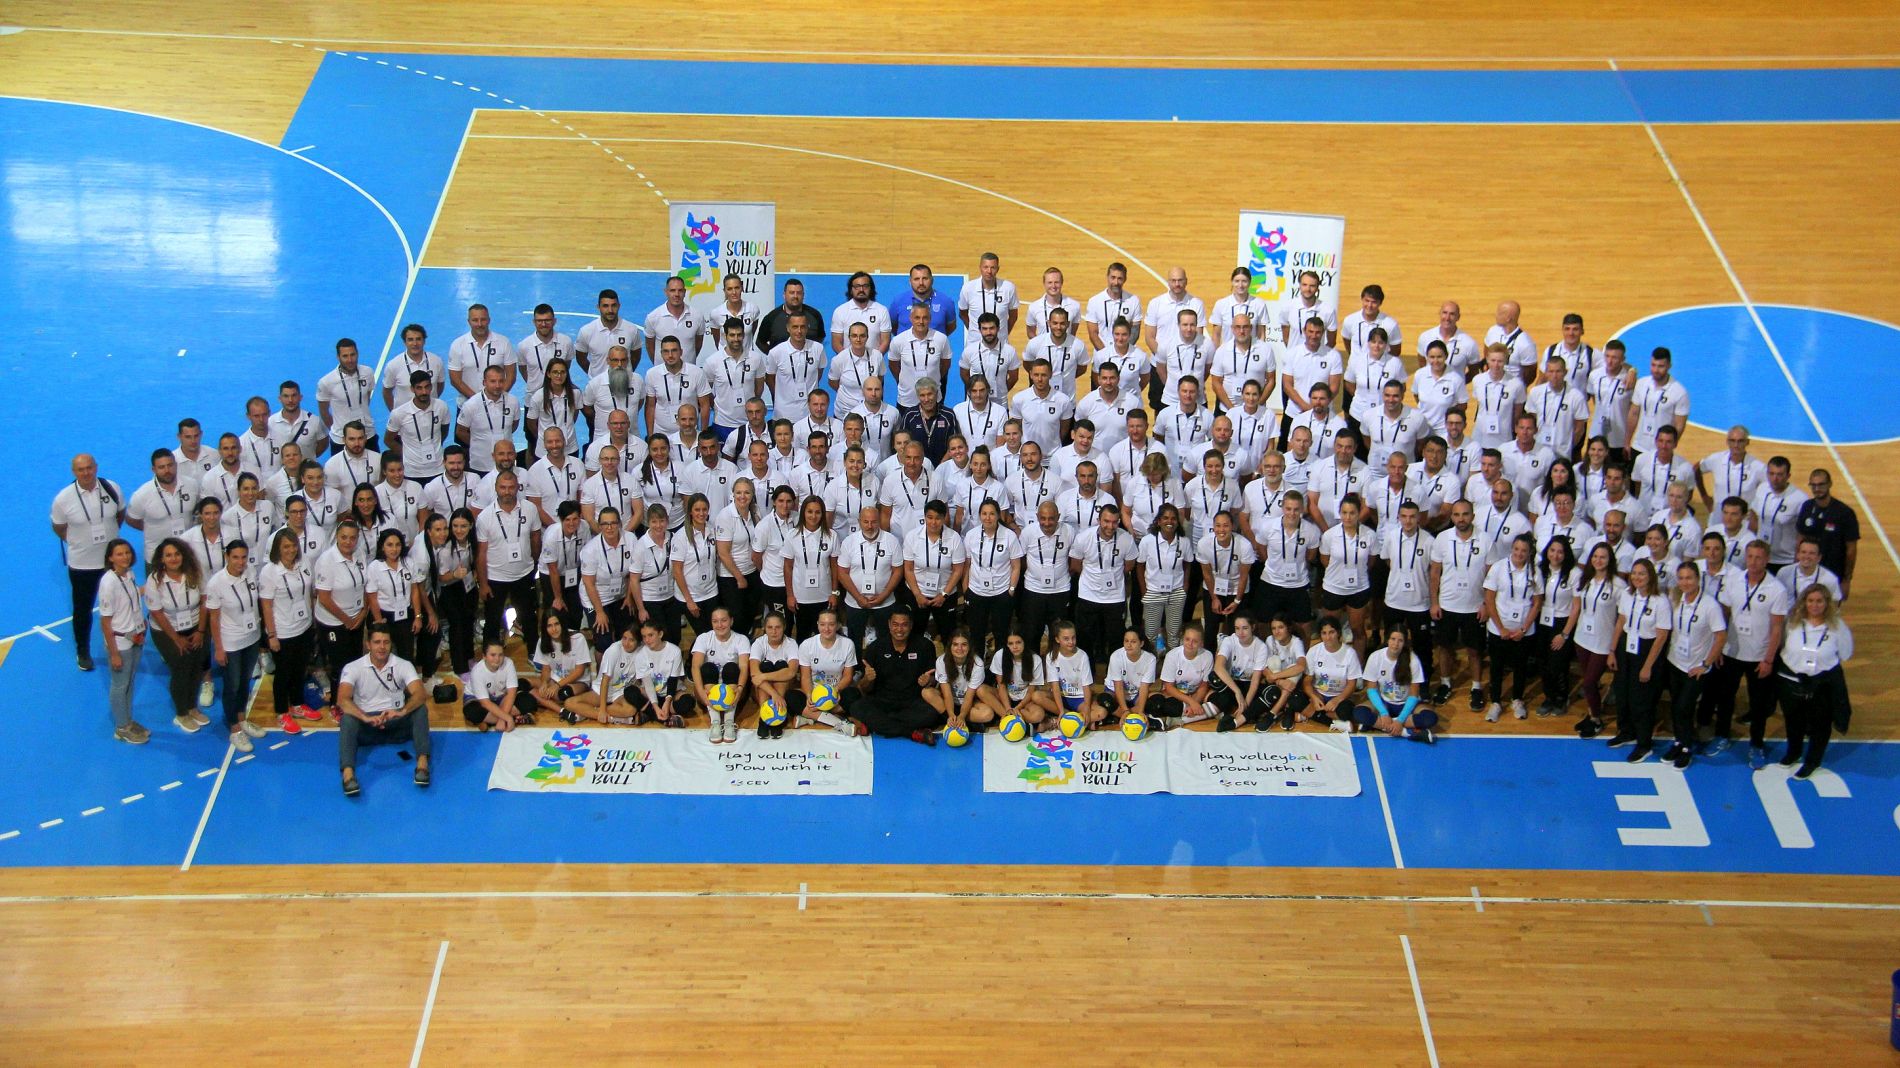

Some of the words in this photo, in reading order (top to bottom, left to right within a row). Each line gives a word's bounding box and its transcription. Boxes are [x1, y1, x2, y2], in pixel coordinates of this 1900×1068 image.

[726, 240, 772, 257] SCHOOL
[1292, 251, 1336, 269] SCHOOL
[726, 259, 772, 275] VOLLEY
[597, 749, 653, 761] SCHOOL
[718, 751, 751, 763] play
[758, 751, 841, 763] volleyball
[1082, 750, 1138, 761] SCHOOL
[1200, 752, 1234, 764] play
[1240, 752, 1322, 764] volleyball
[595, 761, 653, 773] VOLLEY
[725, 763, 765, 771] grow
[772, 763, 811, 771] with
[1081, 762, 1137, 774] VOLLEY
[1210, 764, 1250, 774] grow
[1256, 764, 1295, 772] with
[1301, 764, 1315, 772] it
[592, 773, 632, 785] BALL
[1083, 774, 1124, 785] BALL
